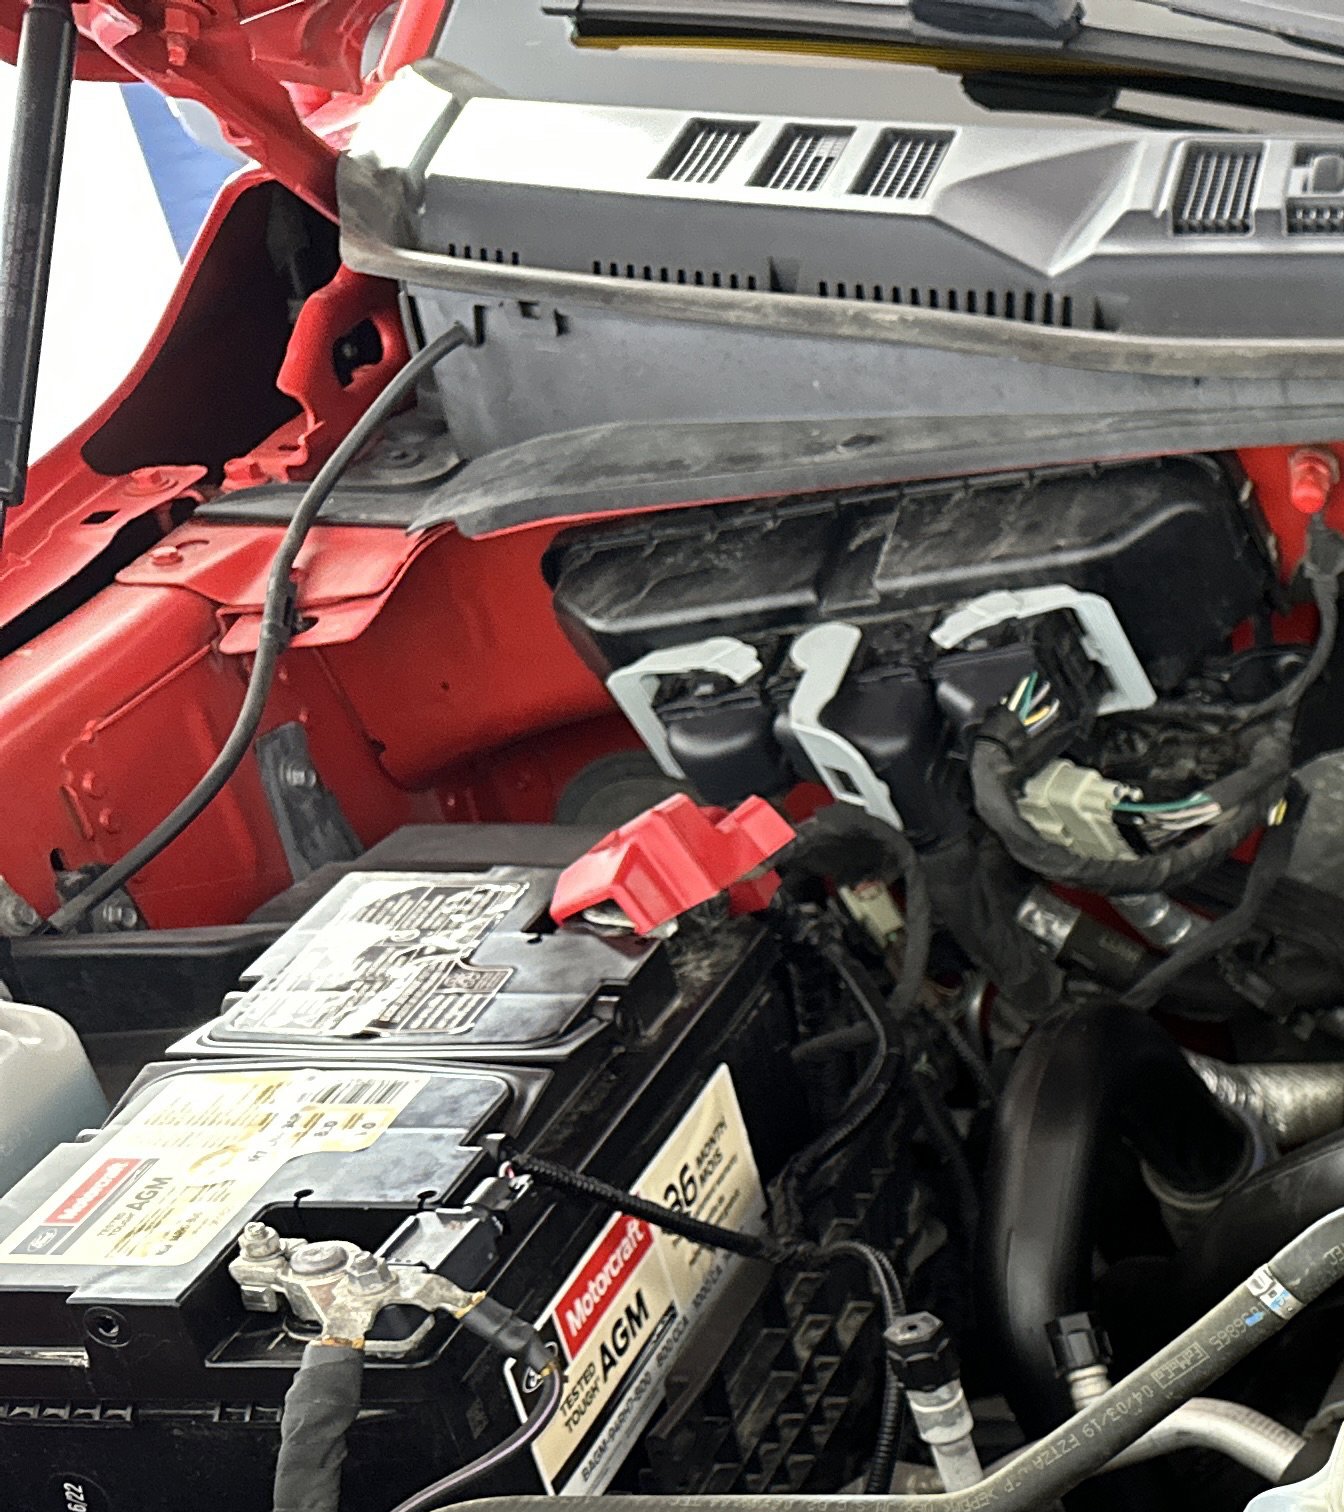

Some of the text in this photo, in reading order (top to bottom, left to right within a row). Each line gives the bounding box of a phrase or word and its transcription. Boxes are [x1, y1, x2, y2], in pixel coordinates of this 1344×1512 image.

[126, 1177, 173, 1211] AGM
[564, 1219, 647, 1338] Motorcraft
[600, 1288, 650, 1384] AGM
[560, 1362, 596, 1417] TESTED
[564, 1379, 602, 1433] TOUGH
[1082, 1384, 1154, 1438] 04/03/19
[63, 1482, 88, 1512] 6/22
